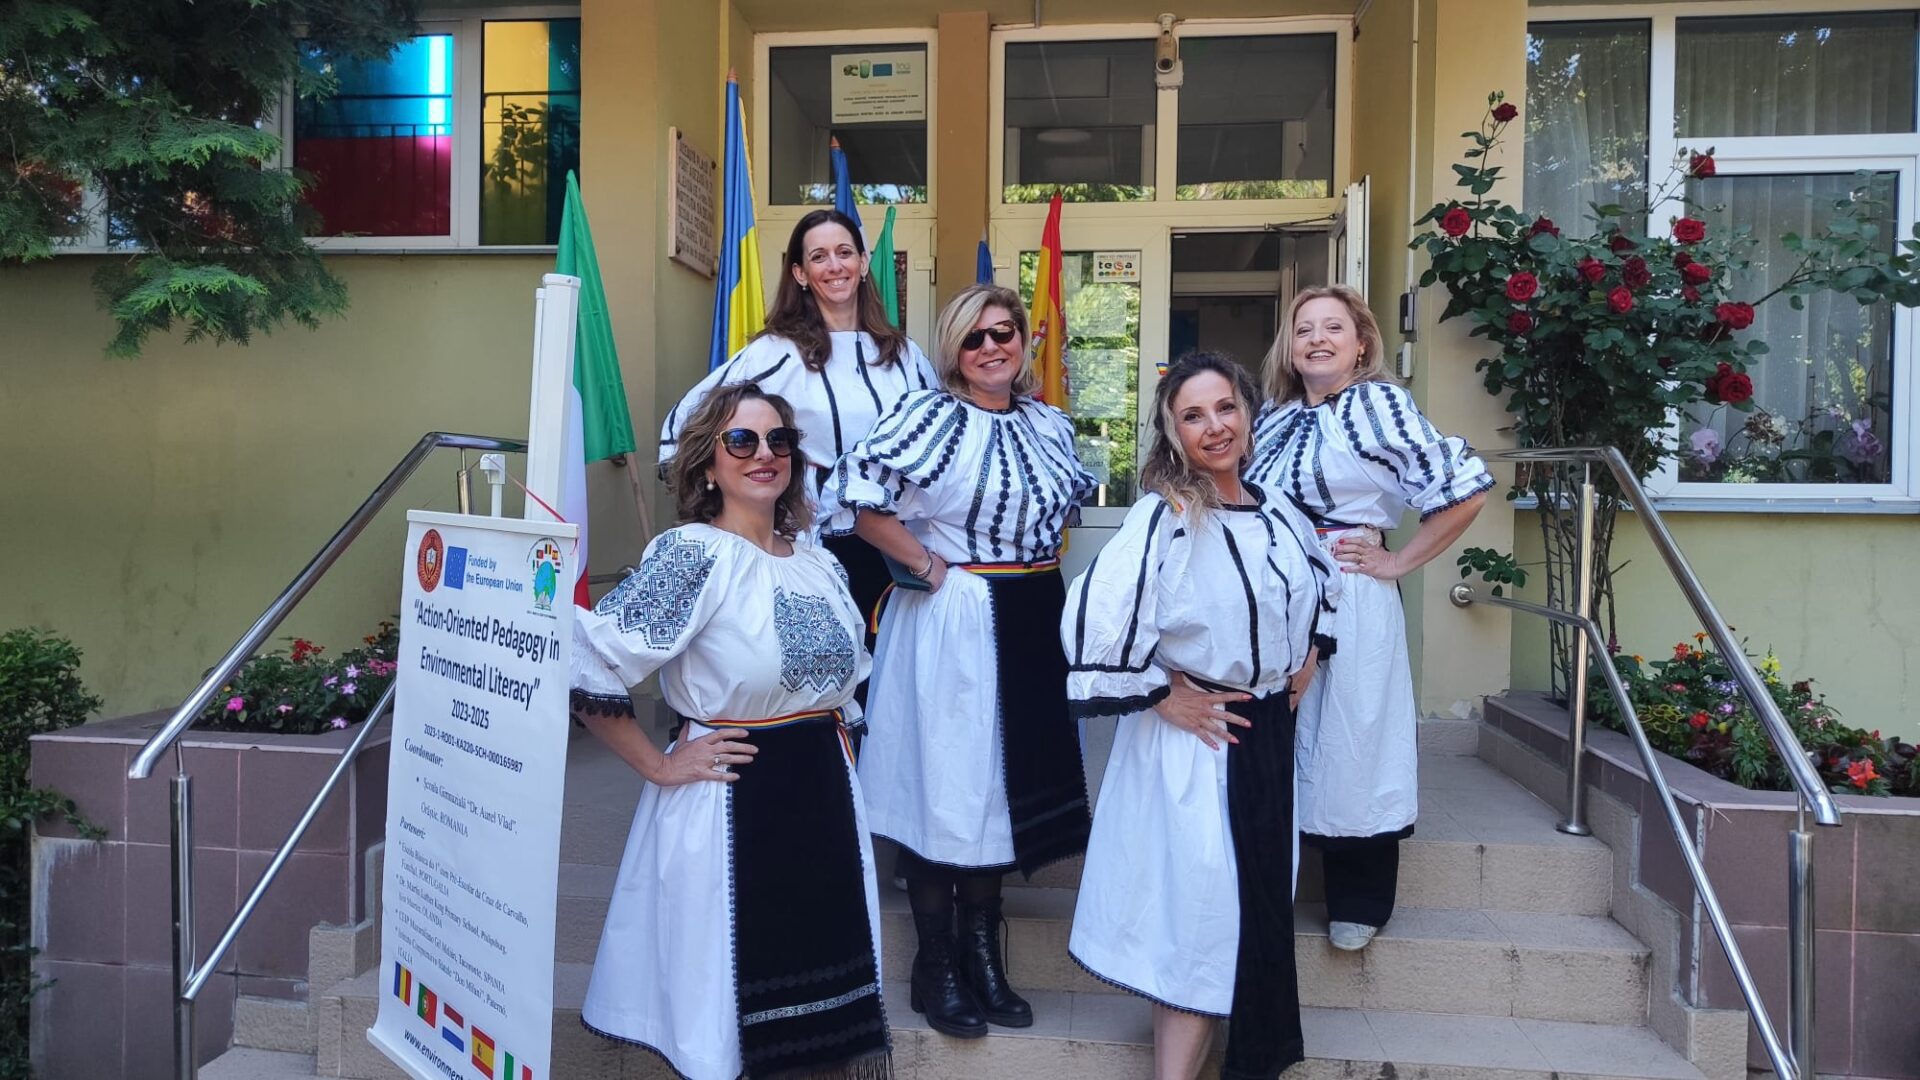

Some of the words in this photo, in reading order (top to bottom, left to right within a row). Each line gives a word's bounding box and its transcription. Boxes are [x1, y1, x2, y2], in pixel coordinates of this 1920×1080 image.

[469, 554, 488, 568] Funded
[489, 557, 497, 572] by
[466, 572, 474, 583] the
[475, 573, 504, 589] European
[505, 578, 523, 592] Union
[491, 619, 548, 664] Pedagogy
[549, 631, 560, 661] in
[420, 647, 486, 690] Environmental
[452, 699, 490, 729] 2023-2025
[404, 738, 444, 767] Coordonator:
[439, 811, 469, 837] ROMANIA
